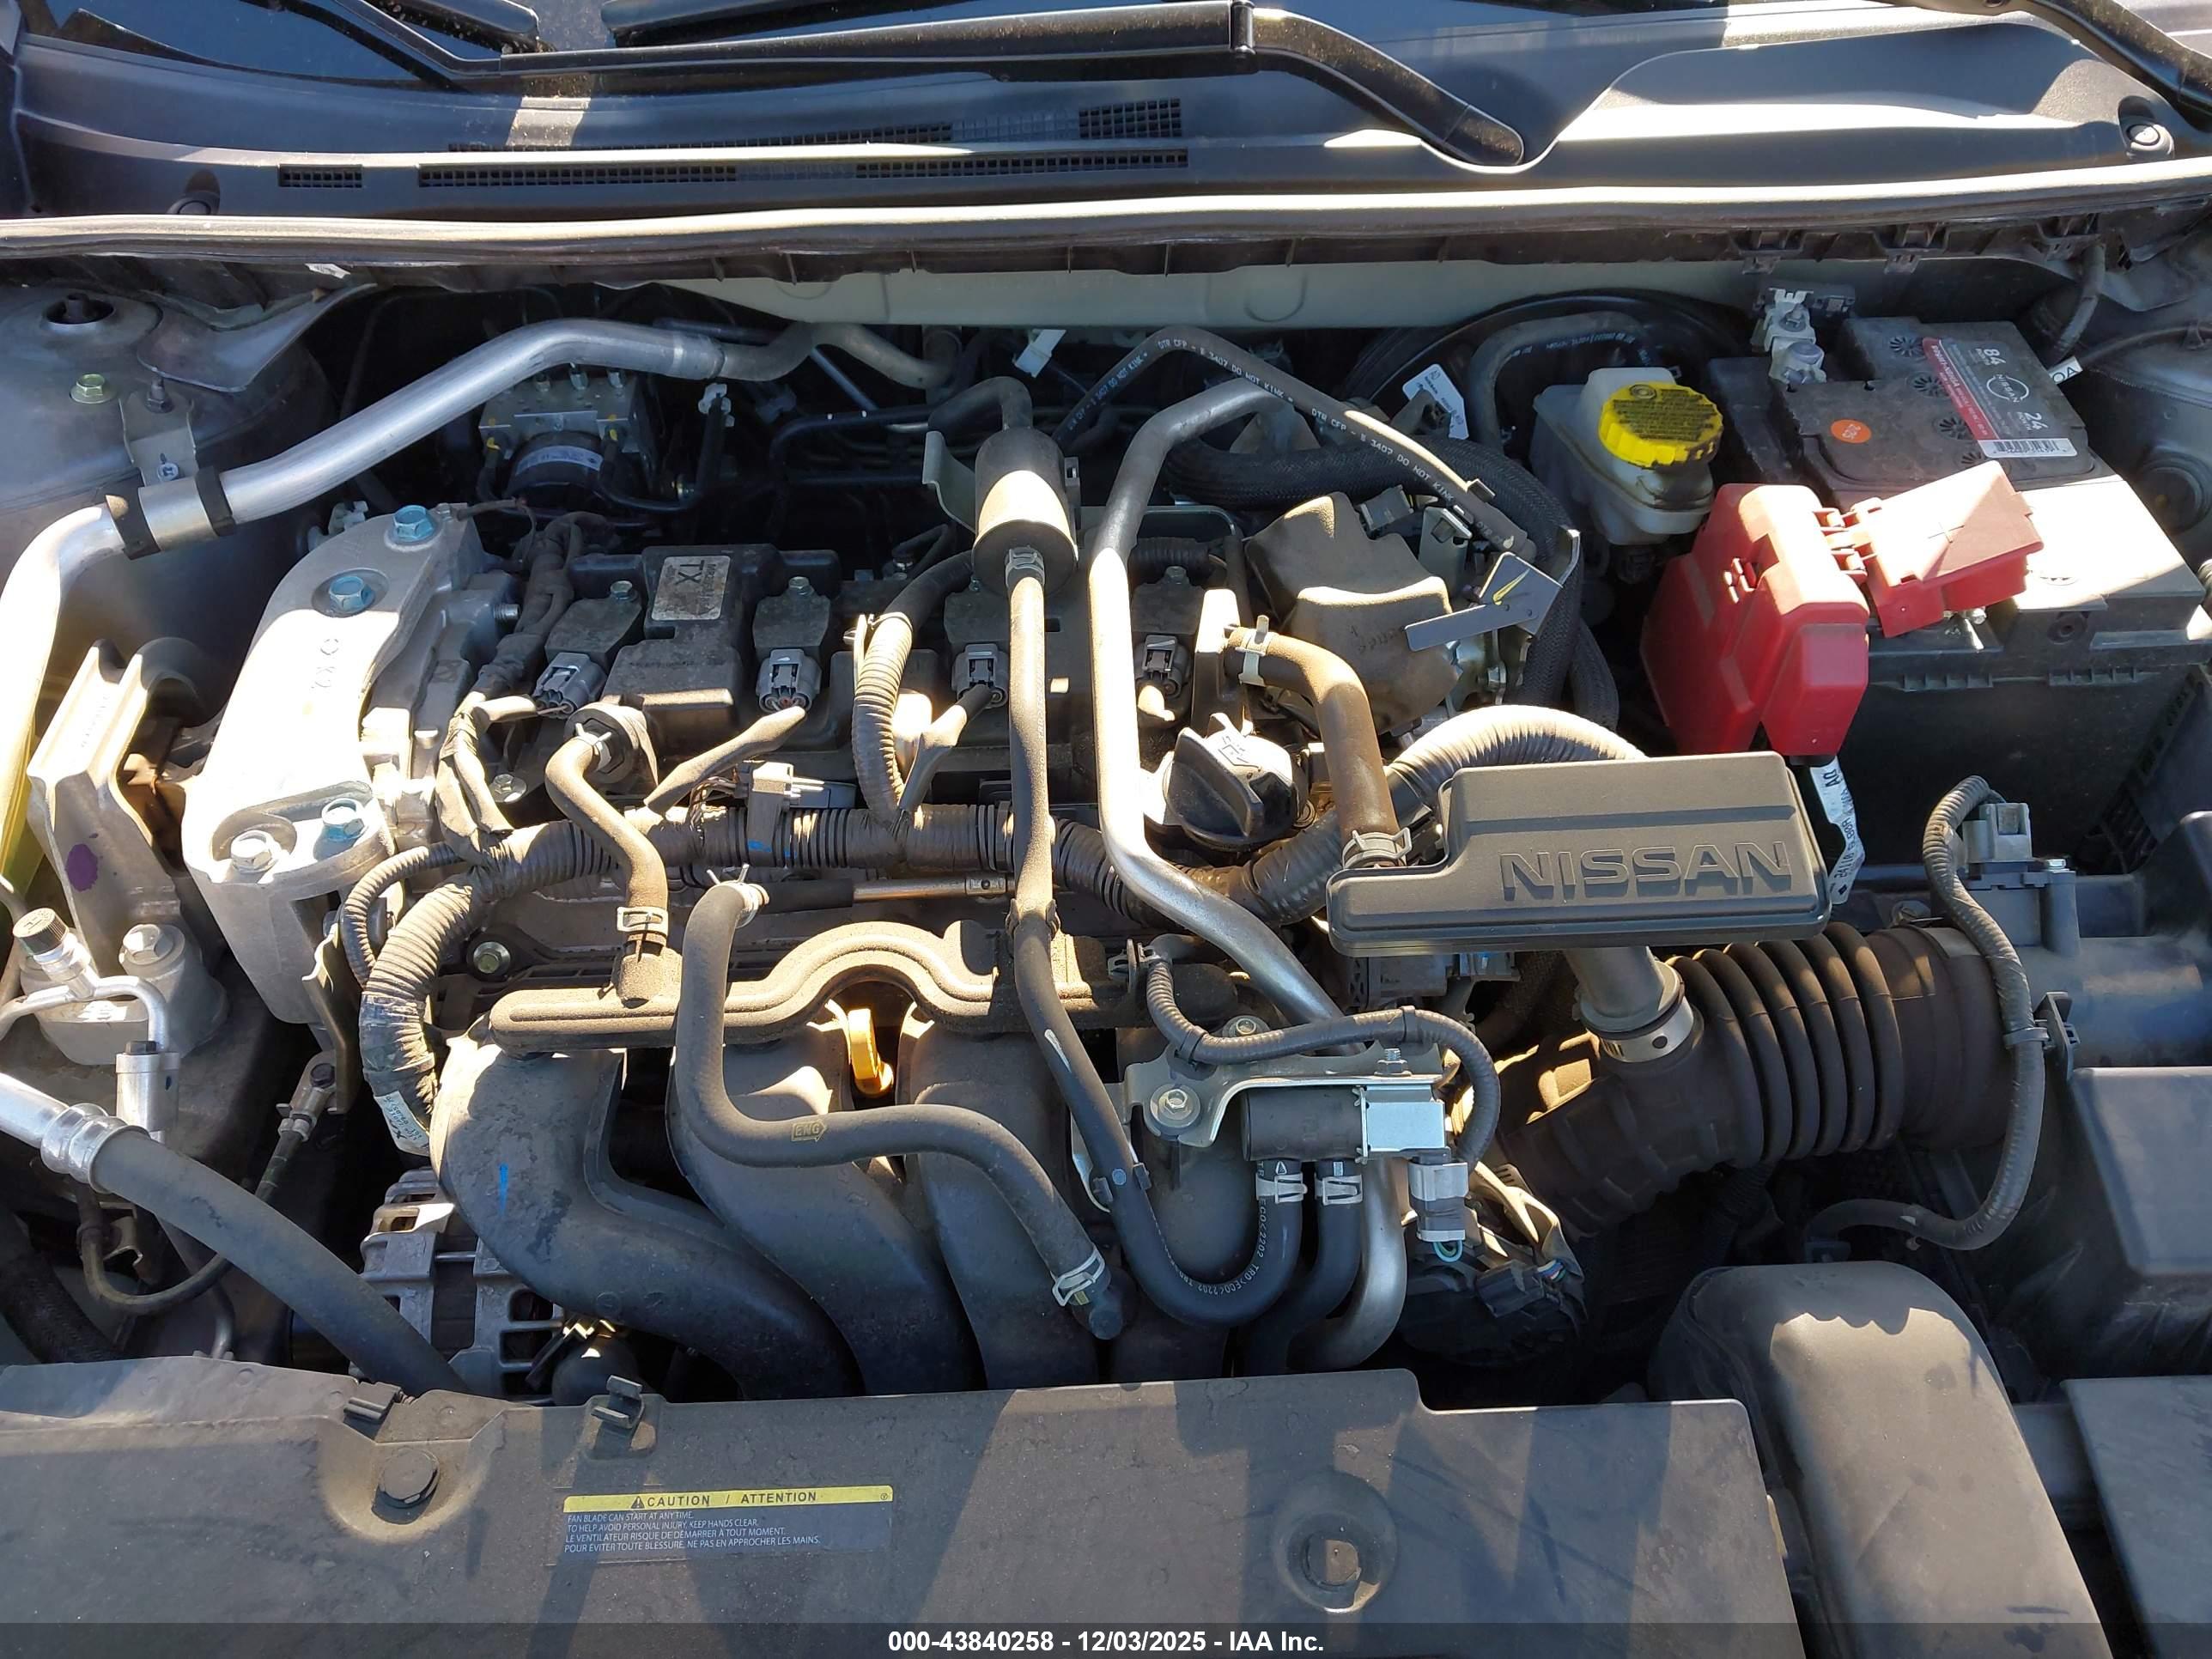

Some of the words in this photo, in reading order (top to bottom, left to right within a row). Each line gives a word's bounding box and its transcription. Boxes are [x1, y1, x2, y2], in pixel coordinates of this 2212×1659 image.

[1984, 349, 2006, 365] 84
[1231, 363, 1242, 377] DO
[1311, 408, 1327, 422] DTR
[1331, 417, 1346, 432] CFP
[1370, 439, 1393, 456] 3407
[1397, 453, 1410, 466] DO
[1413, 465, 1431, 482] NOT
[1432, 482, 1455, 502] KINK
[675, 560, 704, 586] TX
[1500, 841, 1793, 899] NISSAN
[795, 1122, 820, 1136] ENG
[647, 1495, 710, 1507] CAUTION
[741, 1492, 817, 1504] ATTENTION
[584, 1514, 607, 1522] BLADE
[608, 1513, 624, 1522] CAN
[626, 1512, 647, 1521] START
[659, 1511, 674, 1520] ANY
[568, 1524, 578, 1533] TO
[579, 1523, 597, 1532] HELP
[599, 1522, 621, 1531] AVOID
[623, 1522, 659, 1530] PERSONAL
[689, 1520, 707, 1528] KEEP
[708, 1519, 732, 1528] HANDS
[565, 1534, 575, 1542] LE
[577, 1533, 629, 1542] VENTILATEUR
[630, 1532, 660, 1540] RISQUE
[662, 1531, 672, 1540] DE
[672, 1528, 717, 1540] DÉMARRER
[726, 1528, 747, 1537] TOUT
[565, 1544, 587, 1553] POUR
[589, 1542, 616, 1552] ÉVITER
[617, 1542, 642, 1551] TOUTE
[687, 1540, 698, 1548] NE
[700, 1539, 714, 1547] PAS
[716, 1539, 727, 1547] EN
[730, 1537, 775, 1547] APPROCHER
[777, 1536, 791, 1545] LES
[793, 1535, 821, 1544] MAINS.
